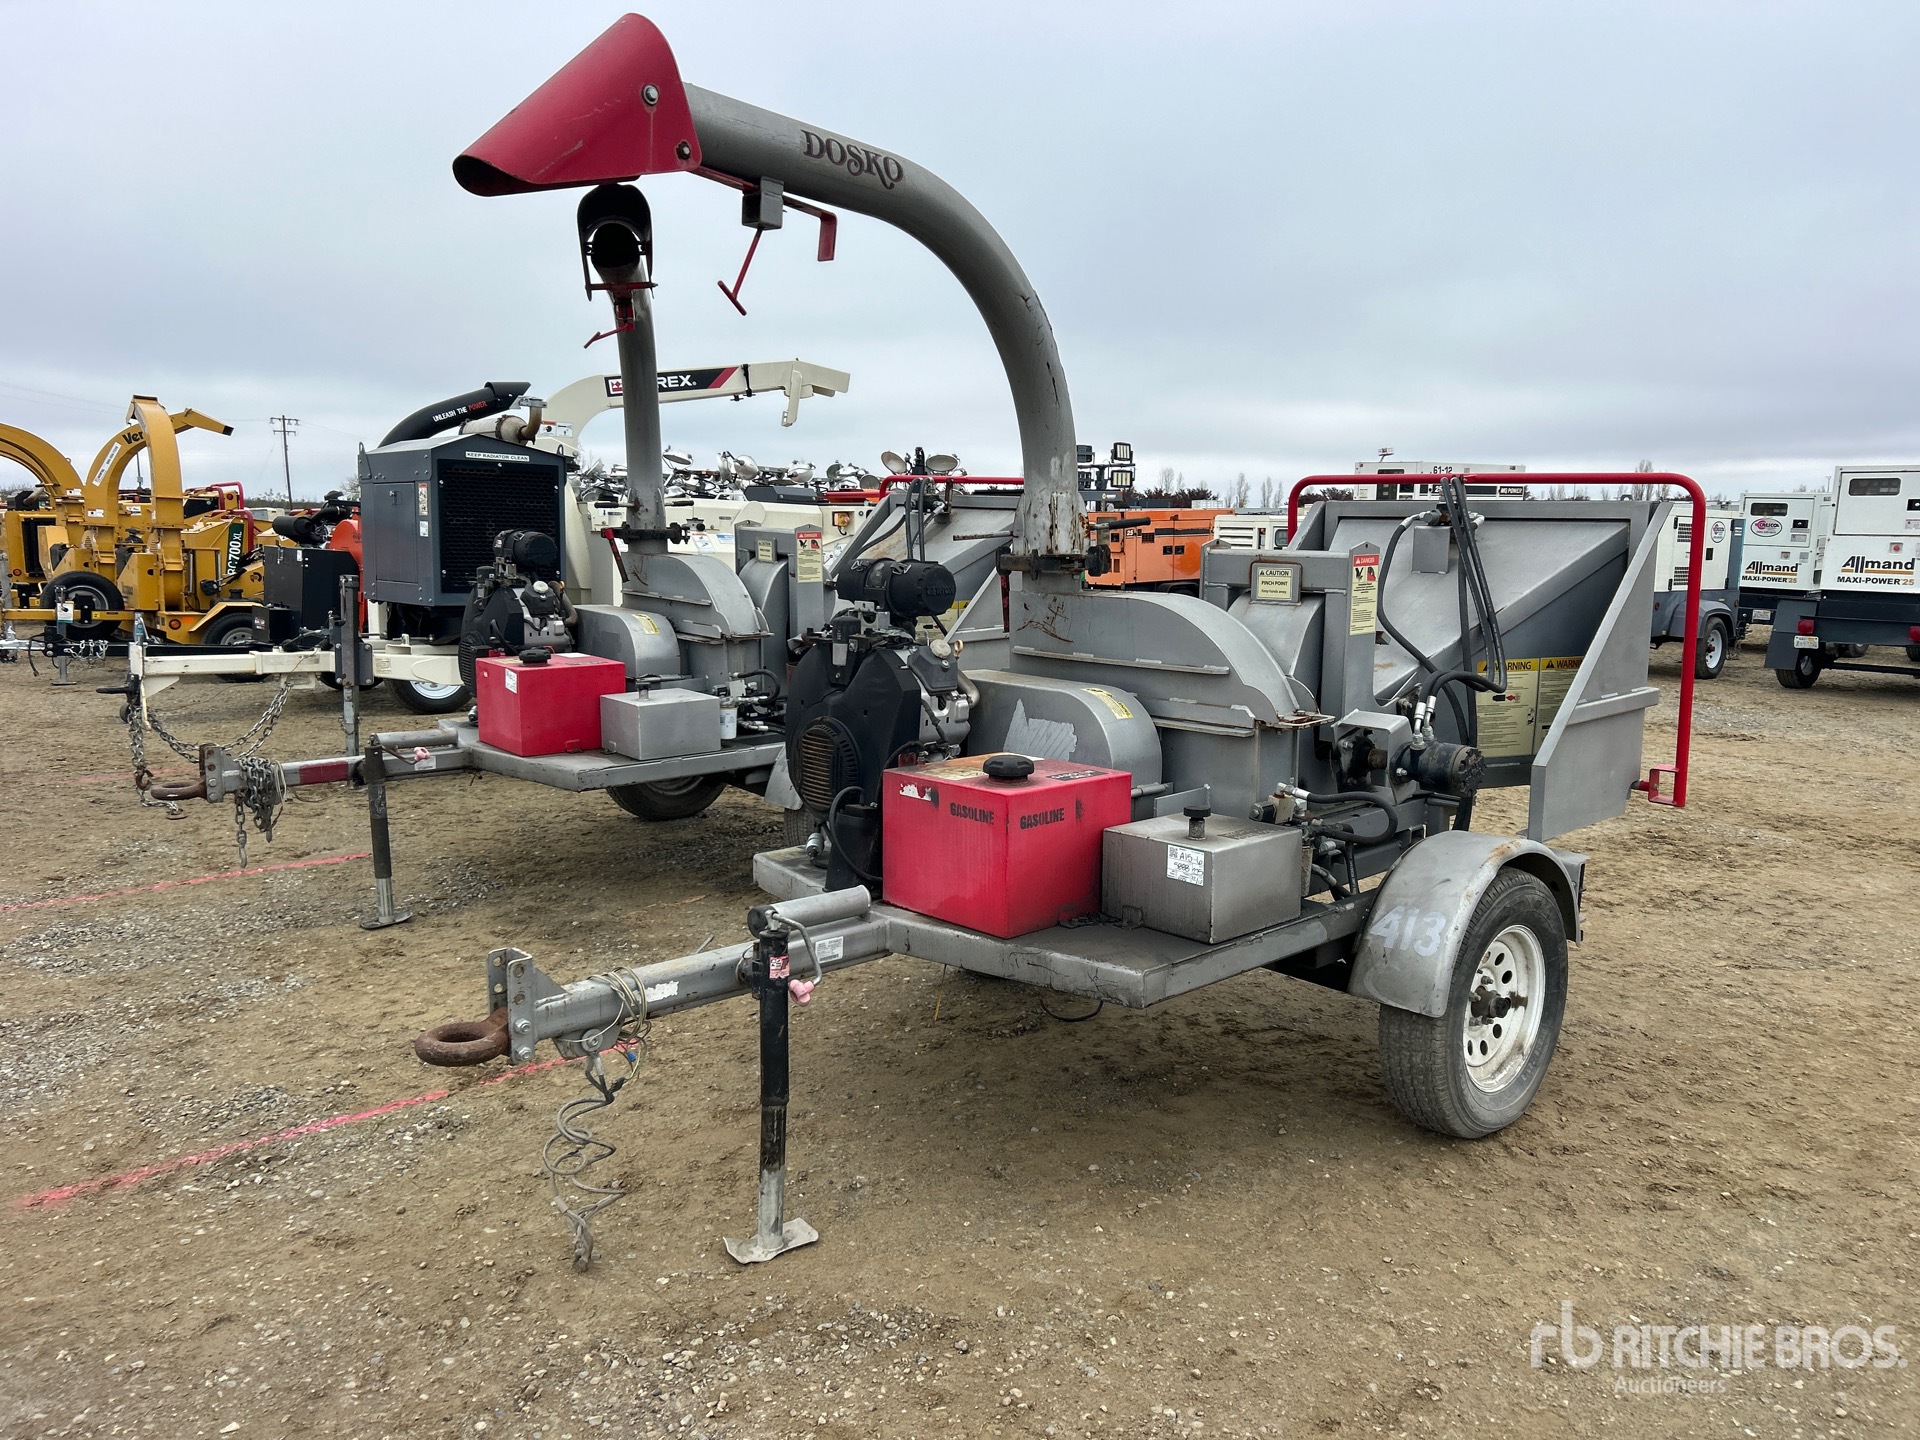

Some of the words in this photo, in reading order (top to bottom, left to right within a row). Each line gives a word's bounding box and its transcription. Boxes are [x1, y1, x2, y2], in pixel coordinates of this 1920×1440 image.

[800, 129, 904, 190] DOSKO
[657, 374, 692, 389] REX
[433, 410, 457, 422] UNLEASH
[457, 406, 468, 415] THE
[468, 401, 488, 411] POWER
[1433, 466, 1453, 474] 61-12
[1746, 561, 1799, 574] Allmand
[1842, 556, 1915, 573] Allmand
[1265, 569, 1289, 577] CAUTION
[1741, 575, 1788, 583] MAXI-POWER
[1837, 576, 1900, 586] MAXI-POWER
[1901, 578, 1915, 586] 25
[950, 803, 994, 825] GASOLINE
[1020, 808, 1065, 829] GASOLINE
[1370, 905, 1446, 957] 413
